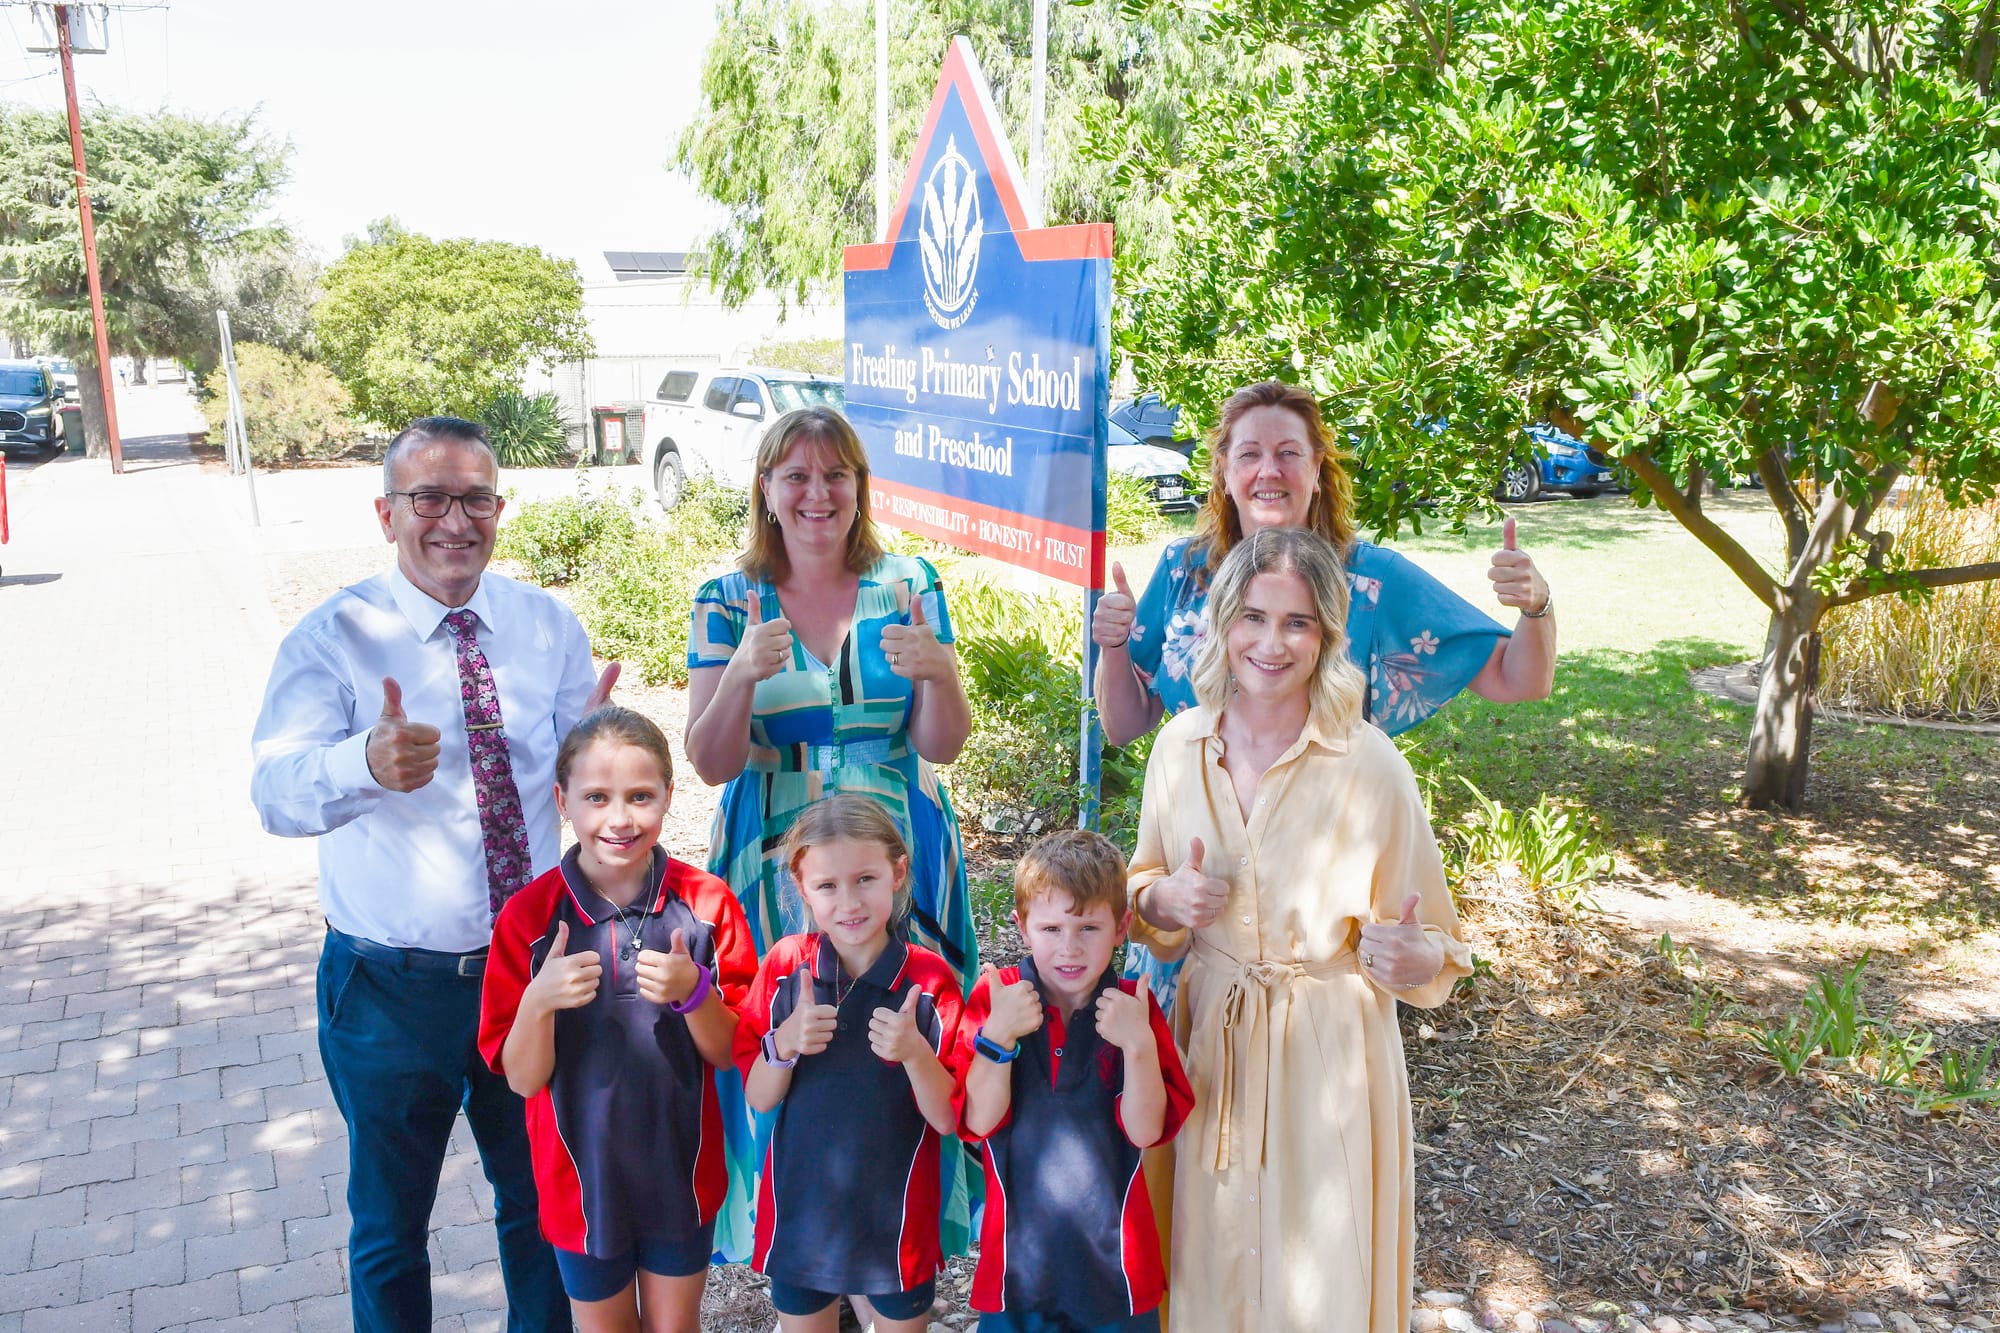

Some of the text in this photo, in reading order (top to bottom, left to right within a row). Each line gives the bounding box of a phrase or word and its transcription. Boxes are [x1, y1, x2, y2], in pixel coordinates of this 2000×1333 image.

[960, 287, 979, 325] LEARN
[852, 343, 1081, 415] Freeling Primary School
[895, 423, 1013, 477] and Preschool
[891, 495, 970, 535] RESPONSIBILITY
[978, 519, 1033, 553] HONESTY
[1044, 536, 1086, 569] TRUST
